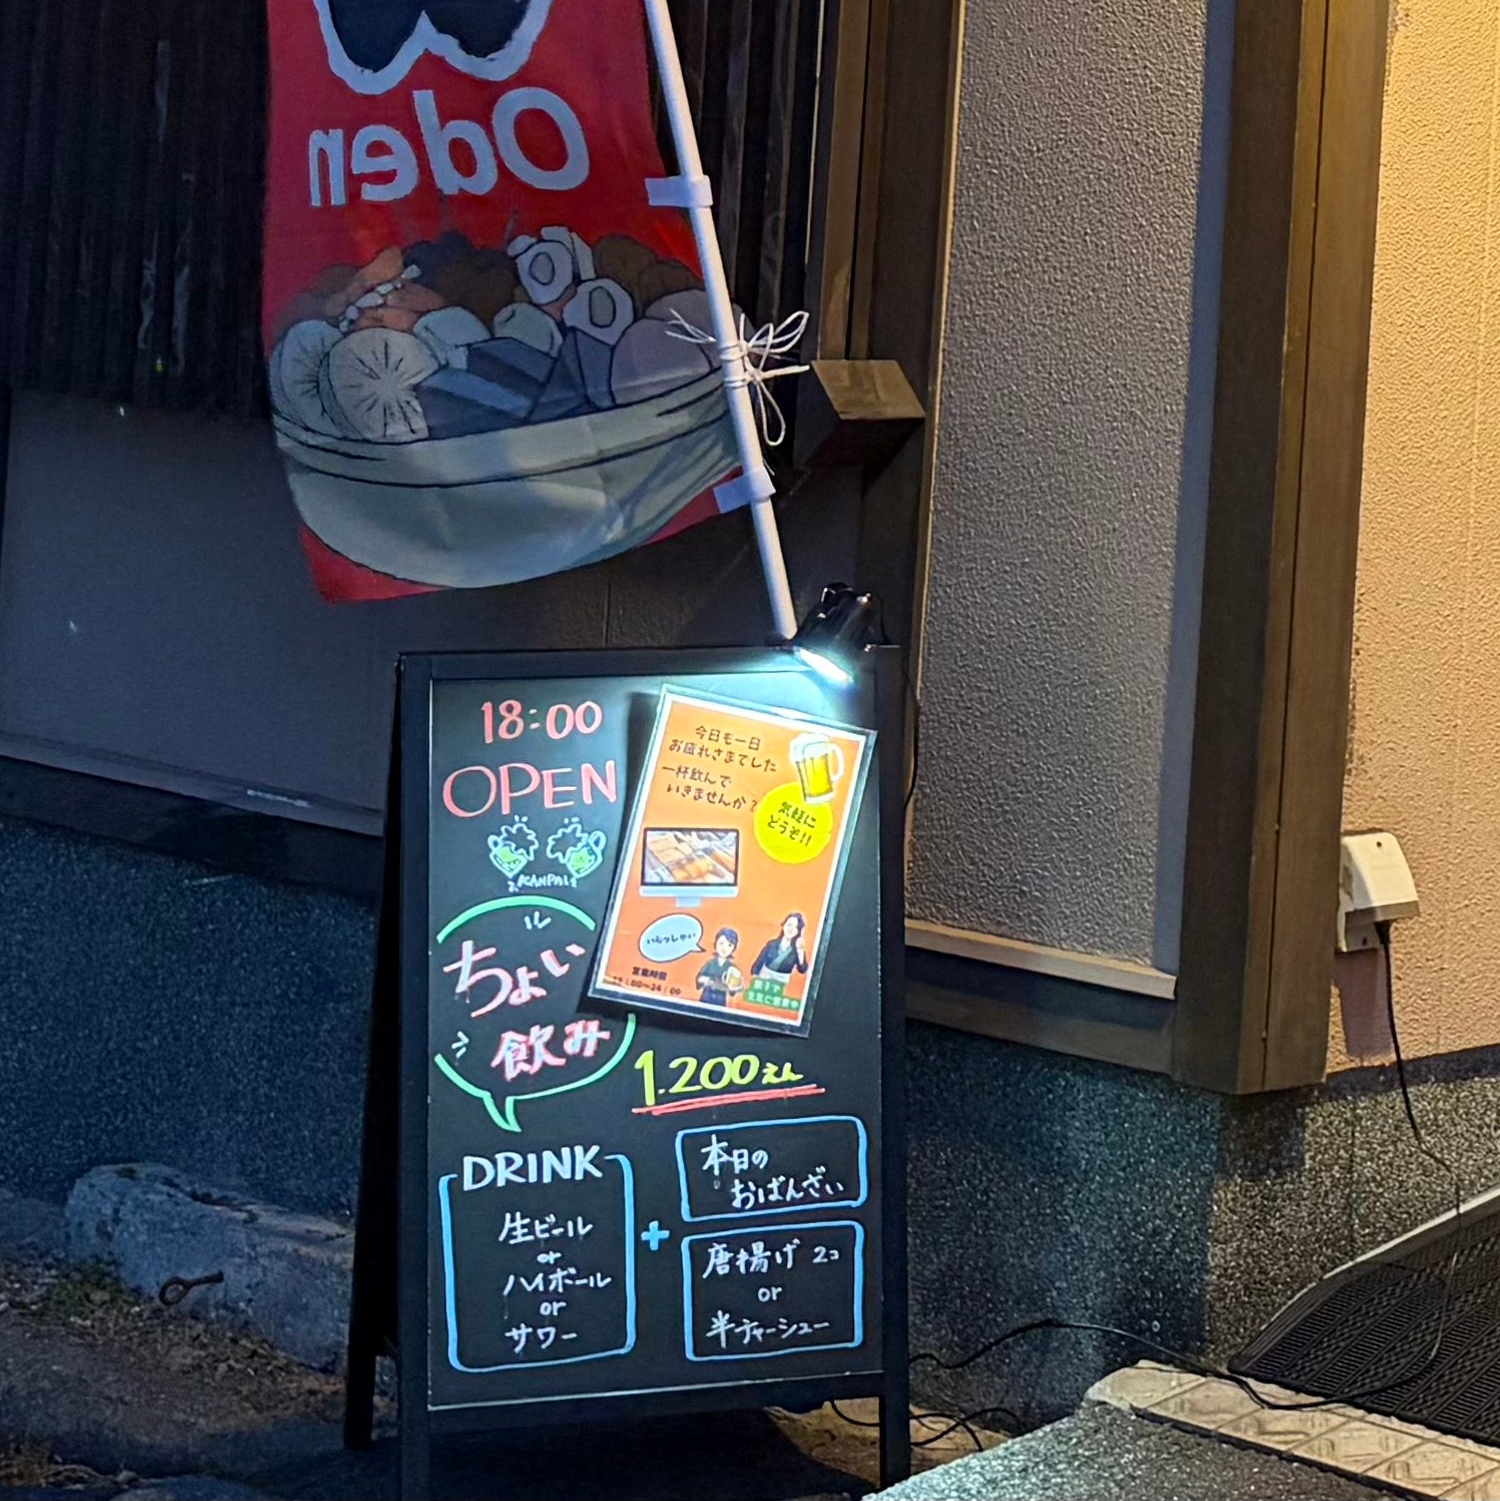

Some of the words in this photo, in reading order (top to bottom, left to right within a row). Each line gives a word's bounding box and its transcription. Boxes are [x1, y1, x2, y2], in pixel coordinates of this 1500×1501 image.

[480, 700, 603, 744] 18:00
[694, 724, 762, 752] 今日も一日
[668, 738, 778, 773] お疲れさまでした
[443, 760, 617, 818] OPEN
[661, 764, 733, 789] 一杯飲んで
[777, 801, 817, 830] 気軽に
[443, 940, 586, 1018] ちょい
[490, 1019, 610, 1082] 飲み
[462, 1144, 604, 1192] DRINK
[700, 1134, 769, 1176] 本日の
[730, 1165, 847, 1211] おばんざい
[498, 1212, 594, 1246] 生ビール
[536, 1250, 562, 1268] or
[703, 1240, 800, 1279] 唐揚げ
[502, 1268, 612, 1297] ハイボール
[758, 1284, 783, 1303] or
[539, 1299, 566, 1318] or
[505, 1324, 578, 1354] サワー
